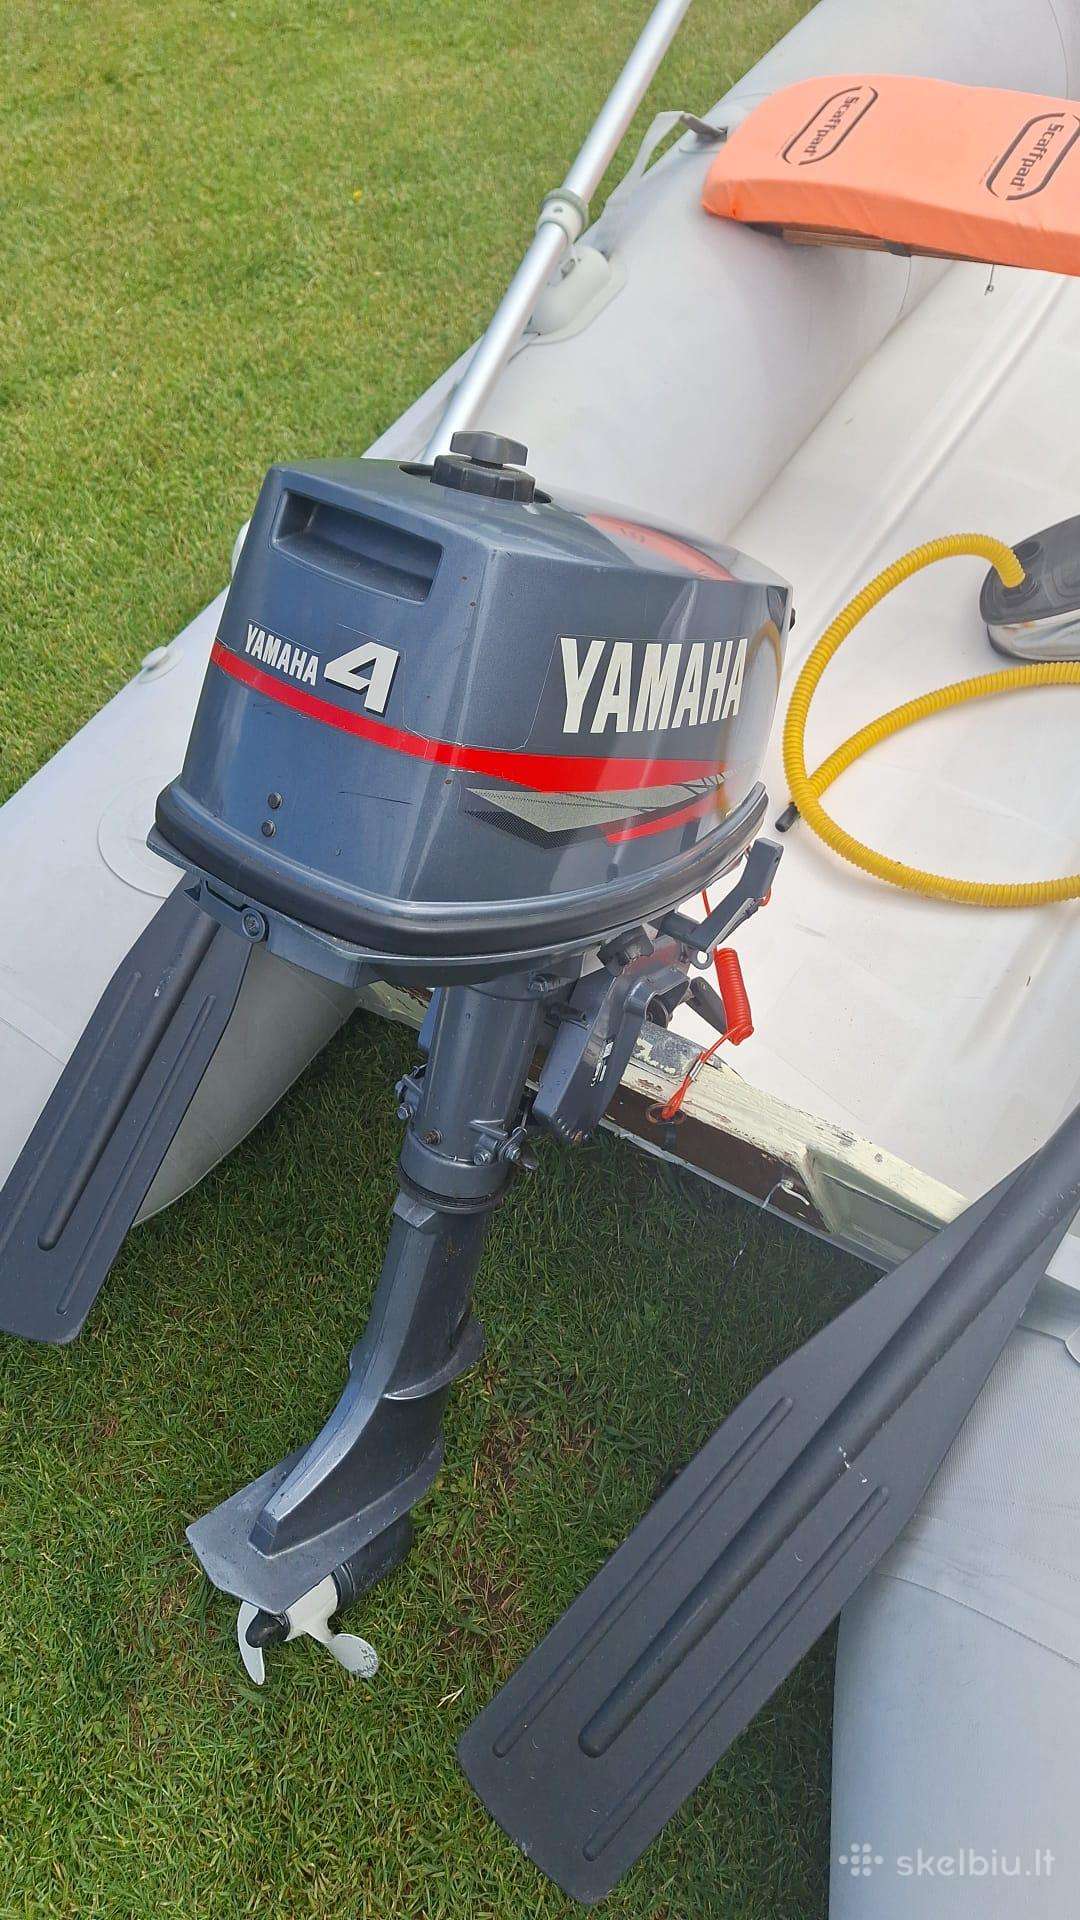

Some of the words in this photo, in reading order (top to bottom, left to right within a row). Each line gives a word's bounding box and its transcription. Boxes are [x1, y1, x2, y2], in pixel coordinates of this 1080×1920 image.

[804, 96, 860, 154] Scaffpad
[1010, 123, 1065, 187] Scaffpad
[245, 624, 320, 687] YAMAHA
[324, 641, 400, 717] 4
[560, 637, 749, 734] YAMAHA
